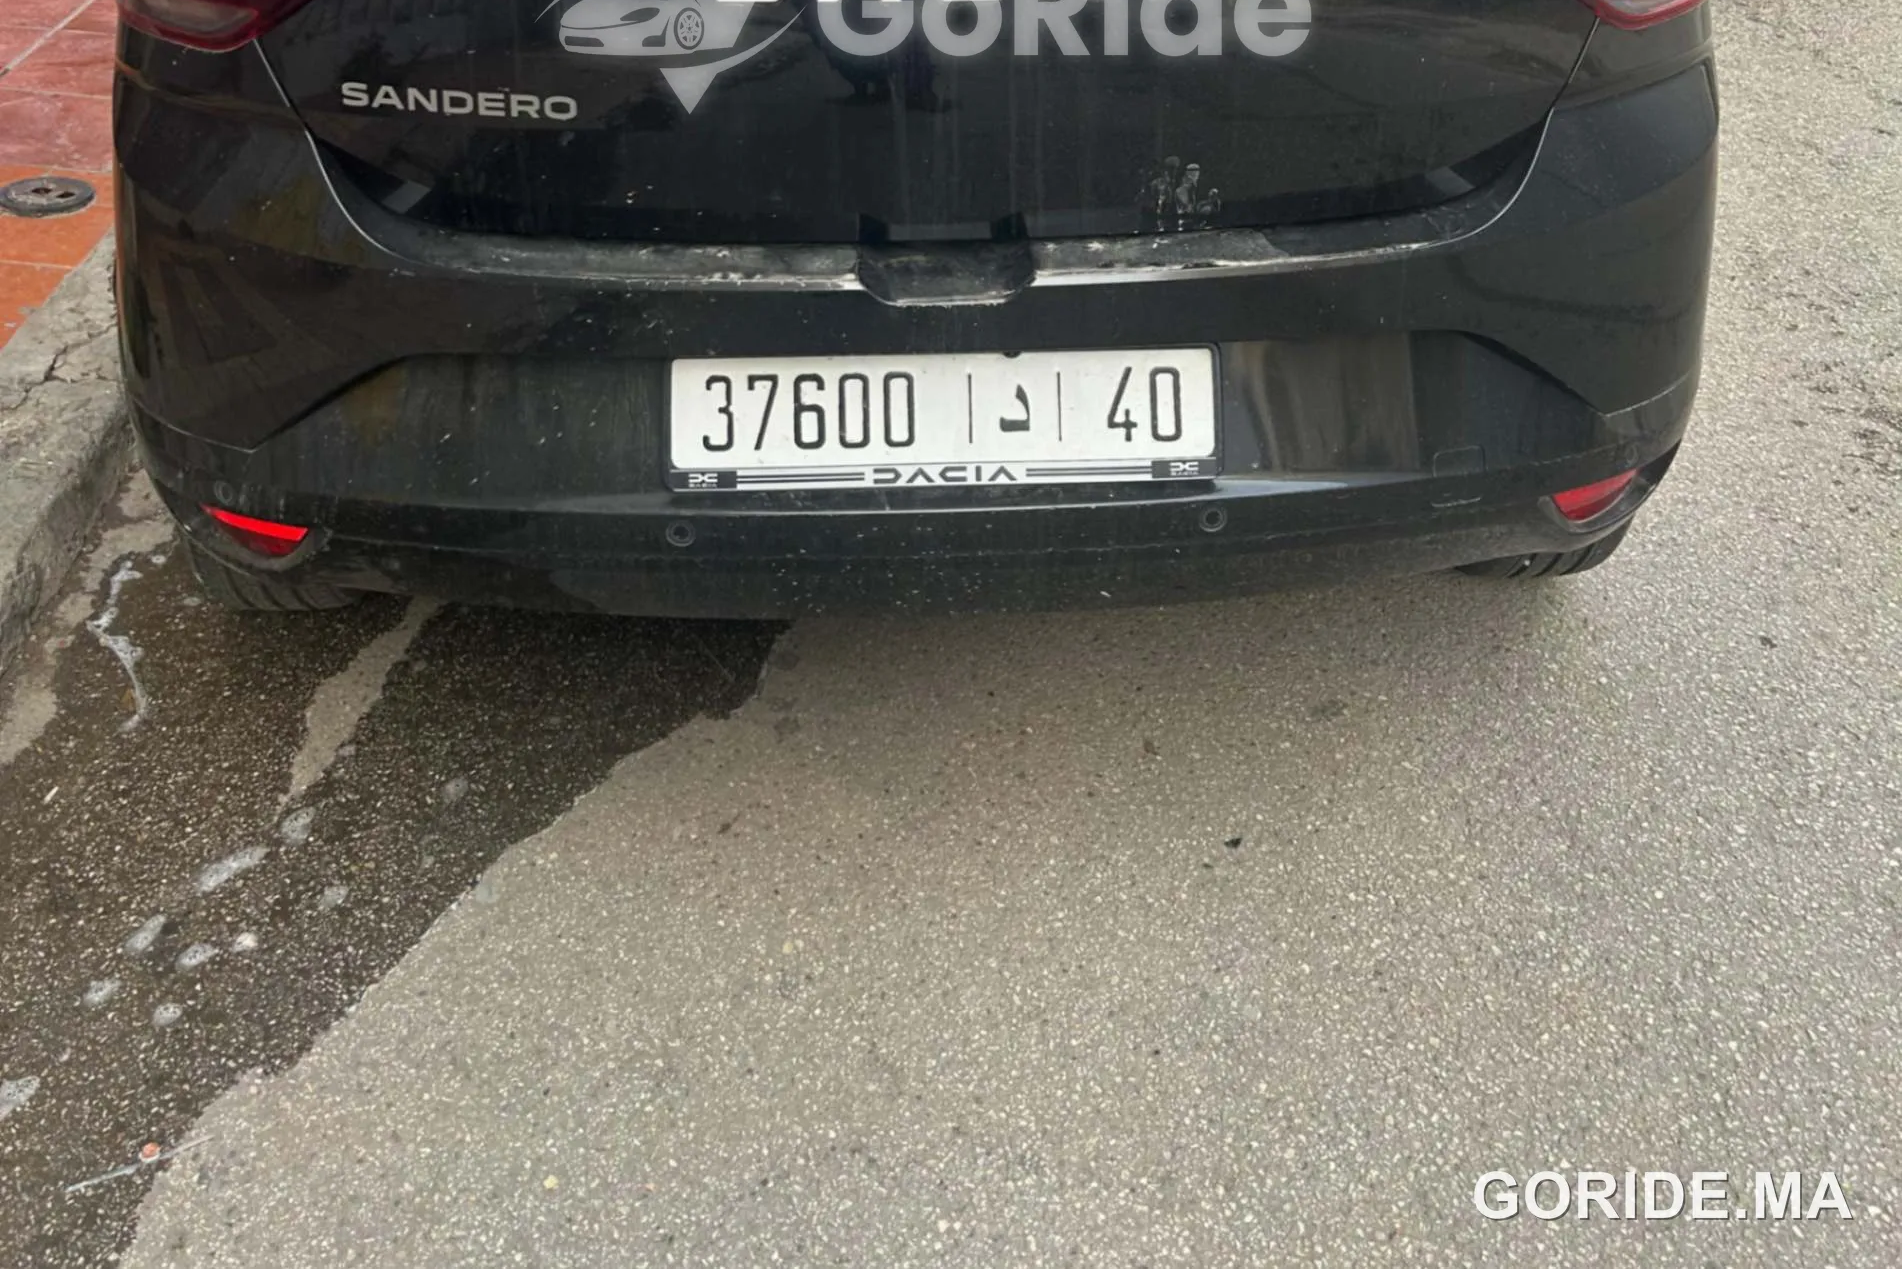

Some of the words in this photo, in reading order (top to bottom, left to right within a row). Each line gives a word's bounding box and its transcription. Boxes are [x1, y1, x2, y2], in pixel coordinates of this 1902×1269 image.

[341, 81, 578, 121] SANDERO
[702, 371, 915, 452] 37600
[1107, 366, 1182, 442] 40
[873, 465, 1017, 485] DACIA
